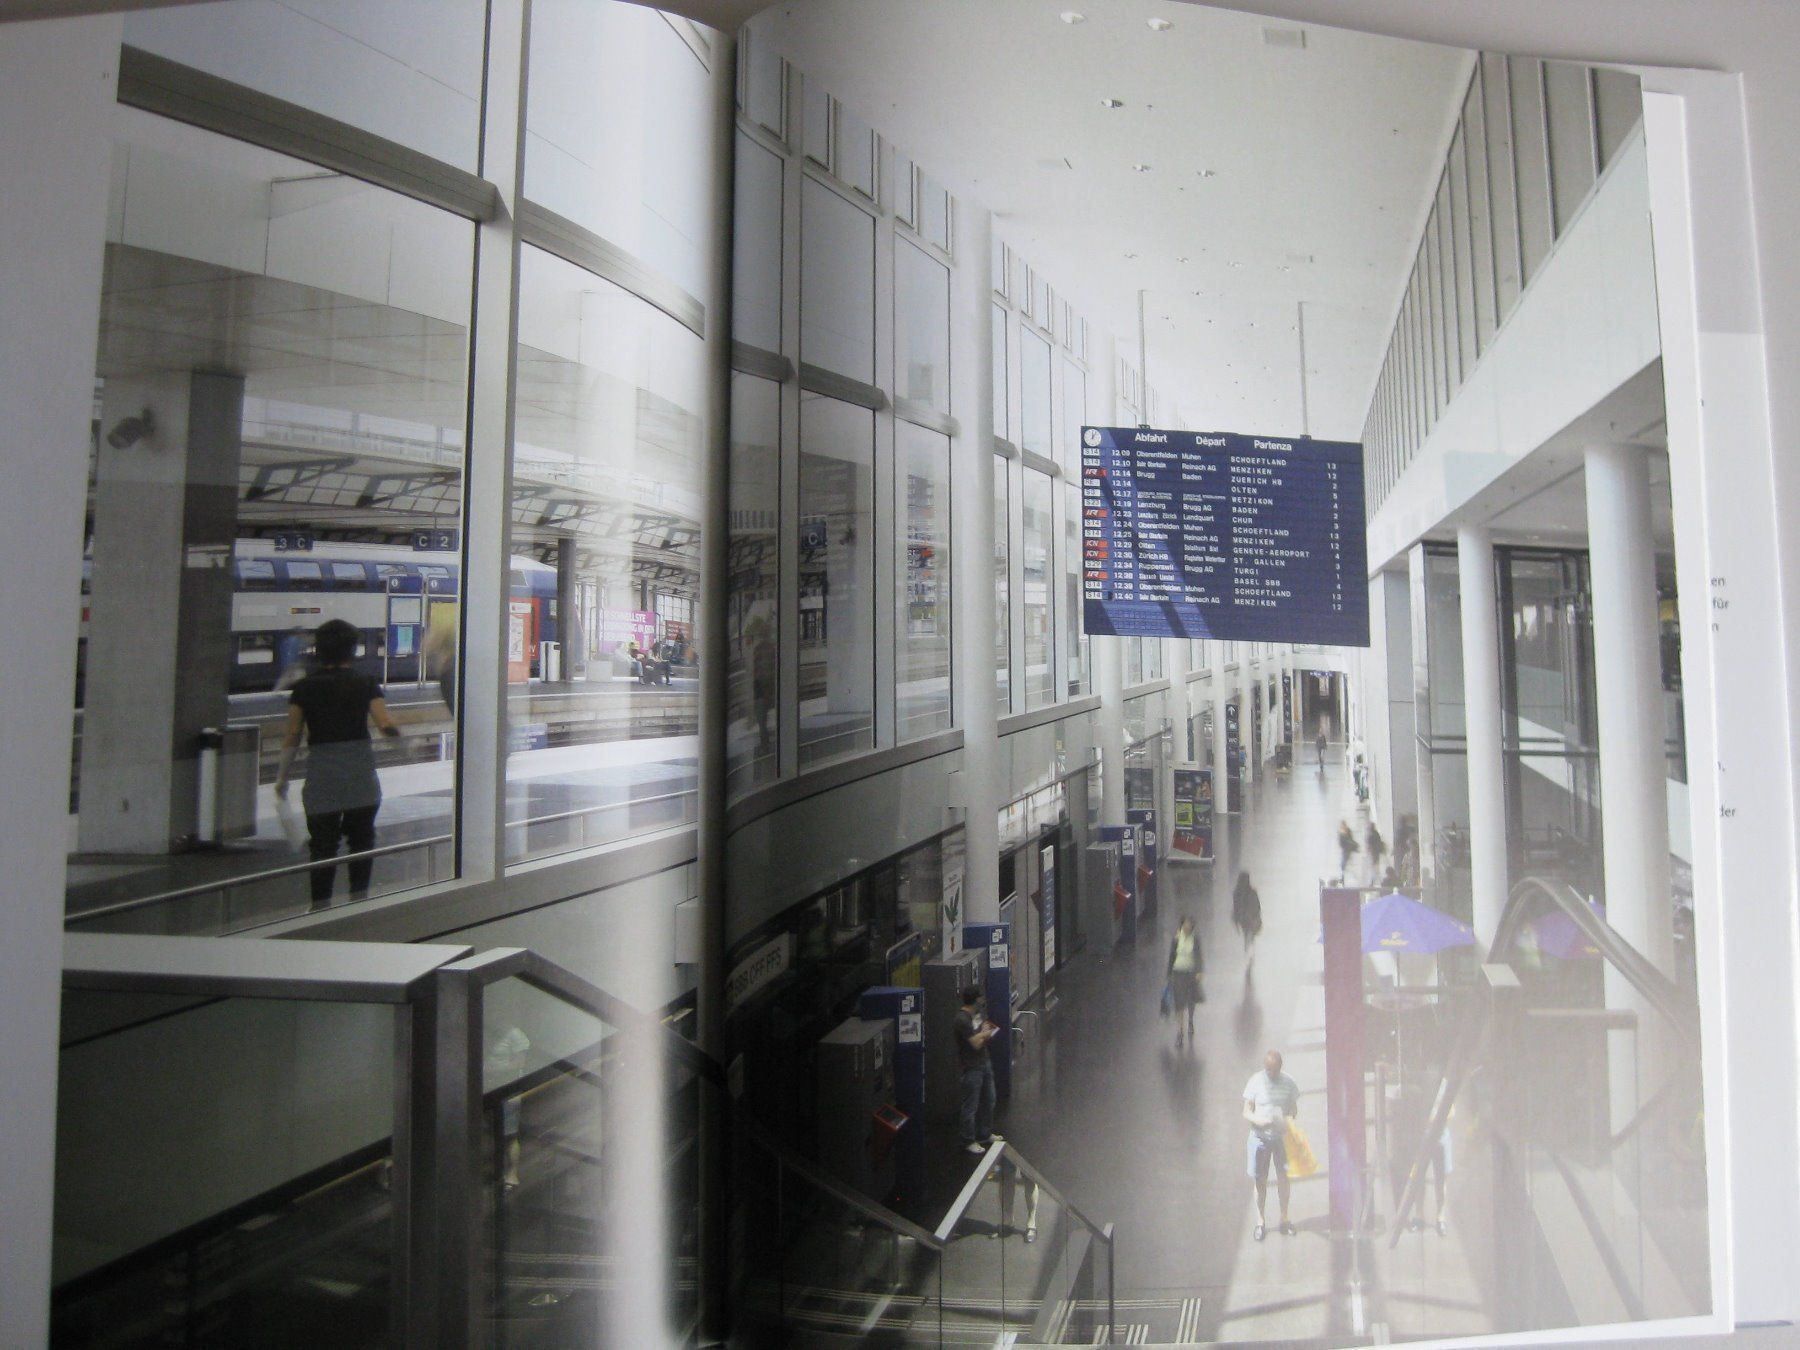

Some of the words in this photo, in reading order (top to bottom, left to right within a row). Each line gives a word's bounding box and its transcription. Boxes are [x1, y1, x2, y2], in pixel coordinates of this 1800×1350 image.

[1135, 433, 1168, 443] Abfahrt
[1196, 436, 1226, 447] Départ
[1254, 440, 1292, 450] Partenza
[1231, 456, 1287, 466] SCHOEFTLAND
[1231, 466, 1272, 475] MENZIKEN
[1232, 497, 1273, 505] WETZIKON
[1183, 514, 1214, 522] Landquart
[1232, 527, 1290, 536] SCHOEFTLAND
[280, 538, 287, 549] 3
[298, 538, 305, 548] C
[419, 536, 428, 547] C
[441, 536, 448, 547] 2
[1232, 537, 1274, 545] MENZIKEN
[1233, 547, 1310, 558] GENEVE-AEROPORT
[1254, 558, 1286, 567] GALLEN
[1234, 588, 1291, 598] SCHOEFTLAND
[1235, 598, 1276, 607] MENZIKEN
[1712, 597, 1729, 609] für
